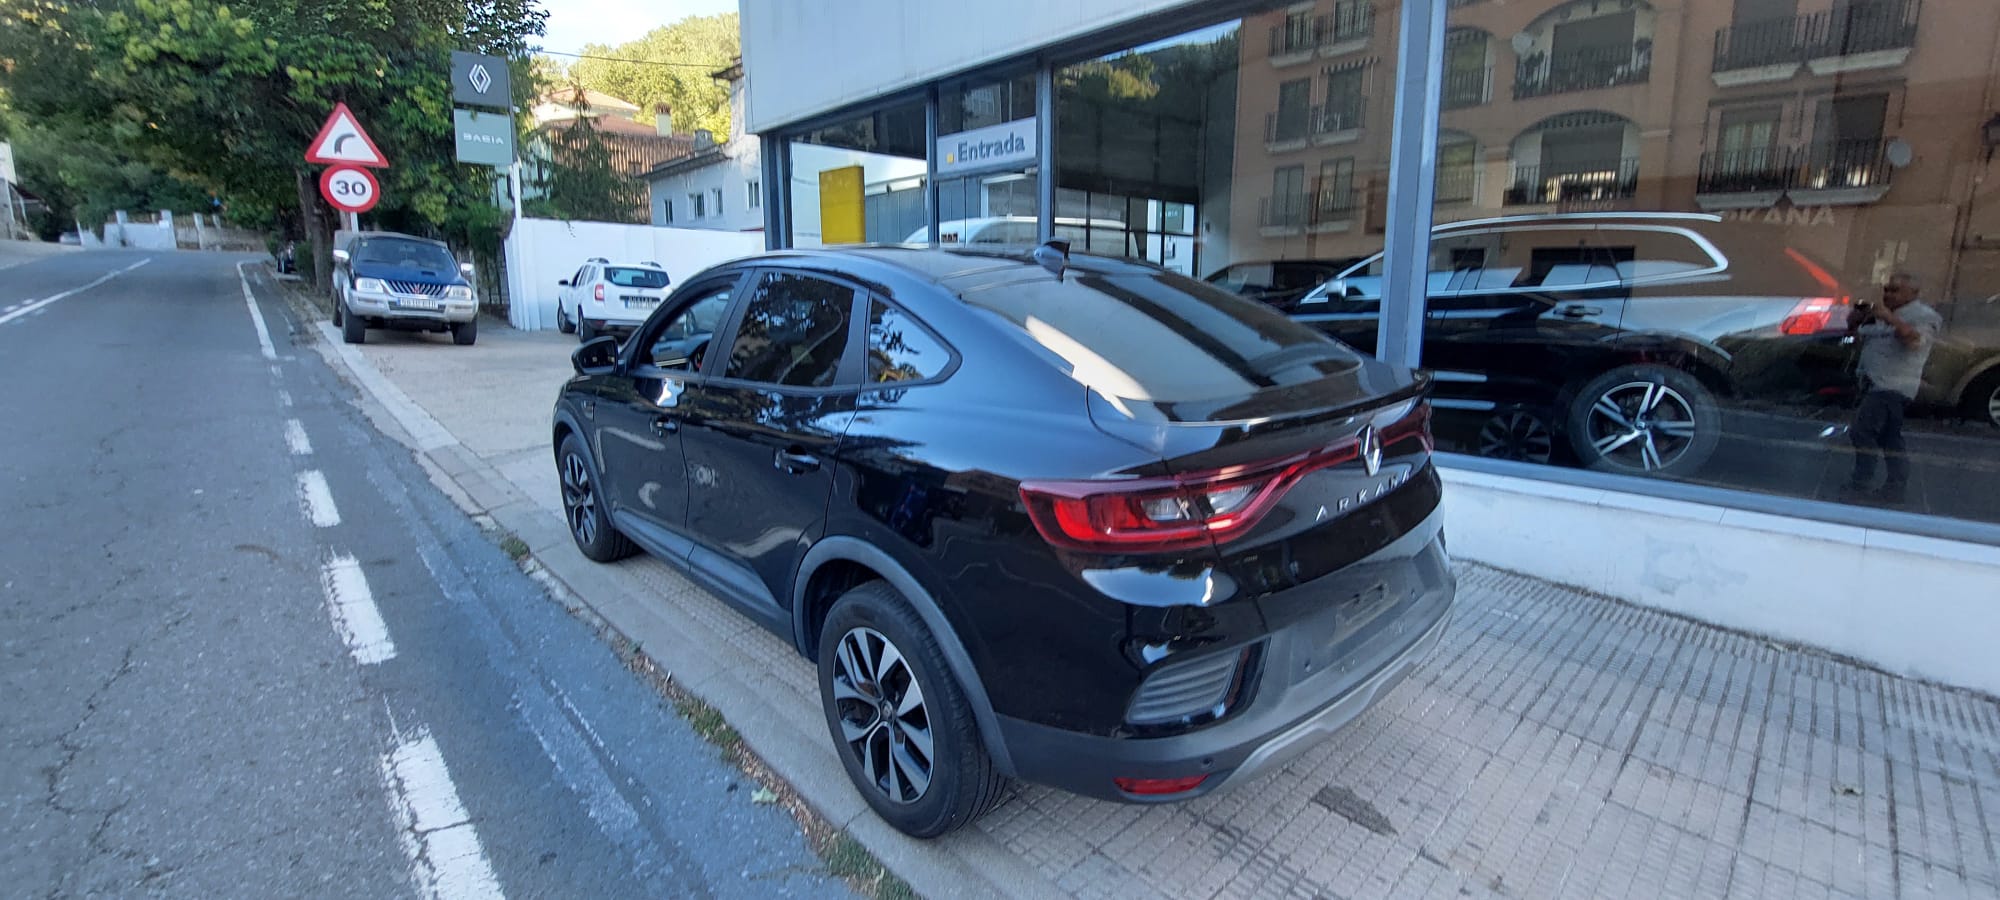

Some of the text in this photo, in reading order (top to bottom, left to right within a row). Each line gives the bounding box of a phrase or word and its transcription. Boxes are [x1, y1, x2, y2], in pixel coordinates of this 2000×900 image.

[958, 130, 1025, 162] Entrada
[336, 180, 366, 196] 30
[1315, 469, 1410, 522] ARKANA
